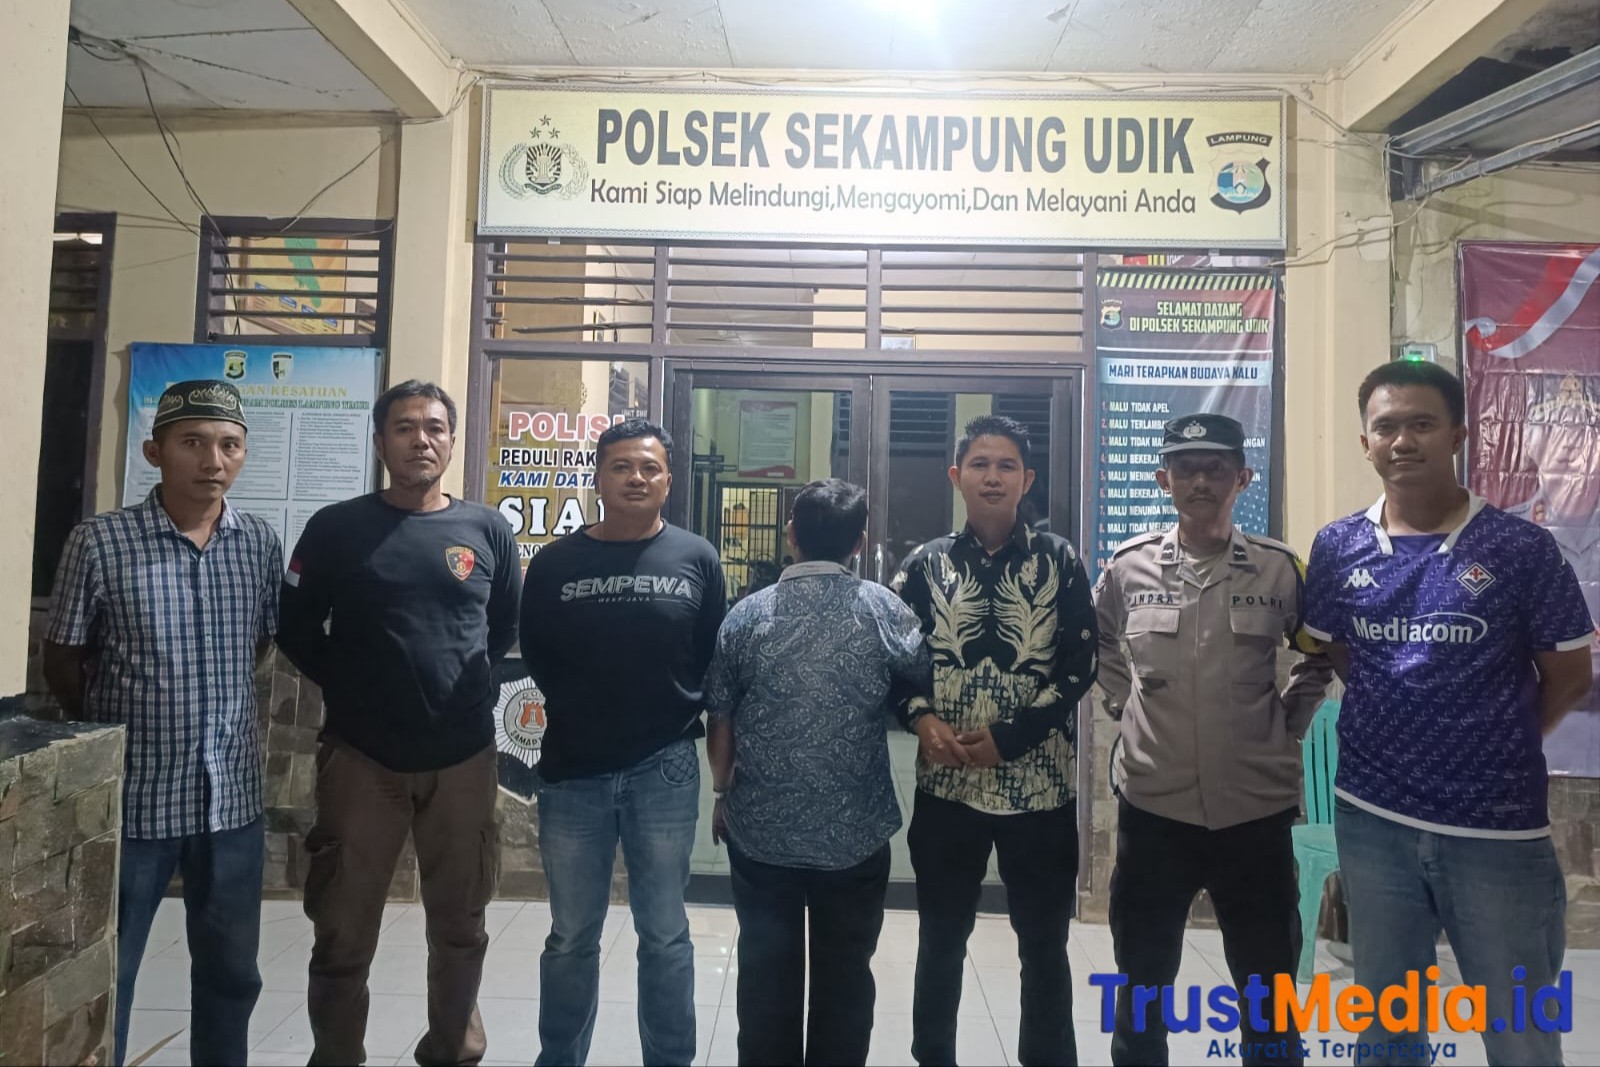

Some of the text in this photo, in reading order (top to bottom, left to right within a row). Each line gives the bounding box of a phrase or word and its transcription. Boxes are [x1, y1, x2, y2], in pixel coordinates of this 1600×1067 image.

[596, 108, 1195, 174] POLSEK SEKAMPUNG UDIK
[1210, 134, 1267, 144] LAMPUNG
[590, 178, 648, 205] Kami
[655, 180, 701, 210] Siap
[1026, 187, 1128, 217] Melayani
[1134, 188, 1196, 213] Anda
[1156, 302, 1243, 317] SELAMAT DATANG
[1129, 317, 1269, 334] DI POLSEK SEKAMPUNG UDIK
[1108, 364, 1134, 378] MARI
[1136, 365, 1188, 379] TERAPKAN
[1190, 366, 1231, 380] BUDAYA
[270, 385, 348, 398] KESATUAN
[1109, 401, 1129, 412] MALU
[1130, 402, 1152, 413] TIDAK
[1152, 402, 1170, 413] APEL
[1109, 419, 1129, 430] MALU
[1108, 436, 1128, 447] MALU
[1130, 437, 1151, 447] TIDAK
[500, 447, 597, 468] PEDULI RAK
[1108, 454, 1128, 464] MALU
[1129, 454, 1160, 465] BEKERJA
[498, 470, 550, 488] KAMI
[1108, 471, 1128, 481] MALU
[1107, 487, 1127, 499] MALU
[1129, 488, 1159, 499] BEKERJA
[498, 495, 605, 537] SIA
[1107, 505, 1127, 516] MALU
[1129, 505, 1161, 516] MENUNDA
[1107, 522, 1127, 534] MALU
[1129, 522, 1148, 534] TIDAK
[560, 575, 693, 602] SEMPEWA
[1133, 593, 1283, 609] INDRA POLRI
[1352, 615, 1475, 644] Mediacom
